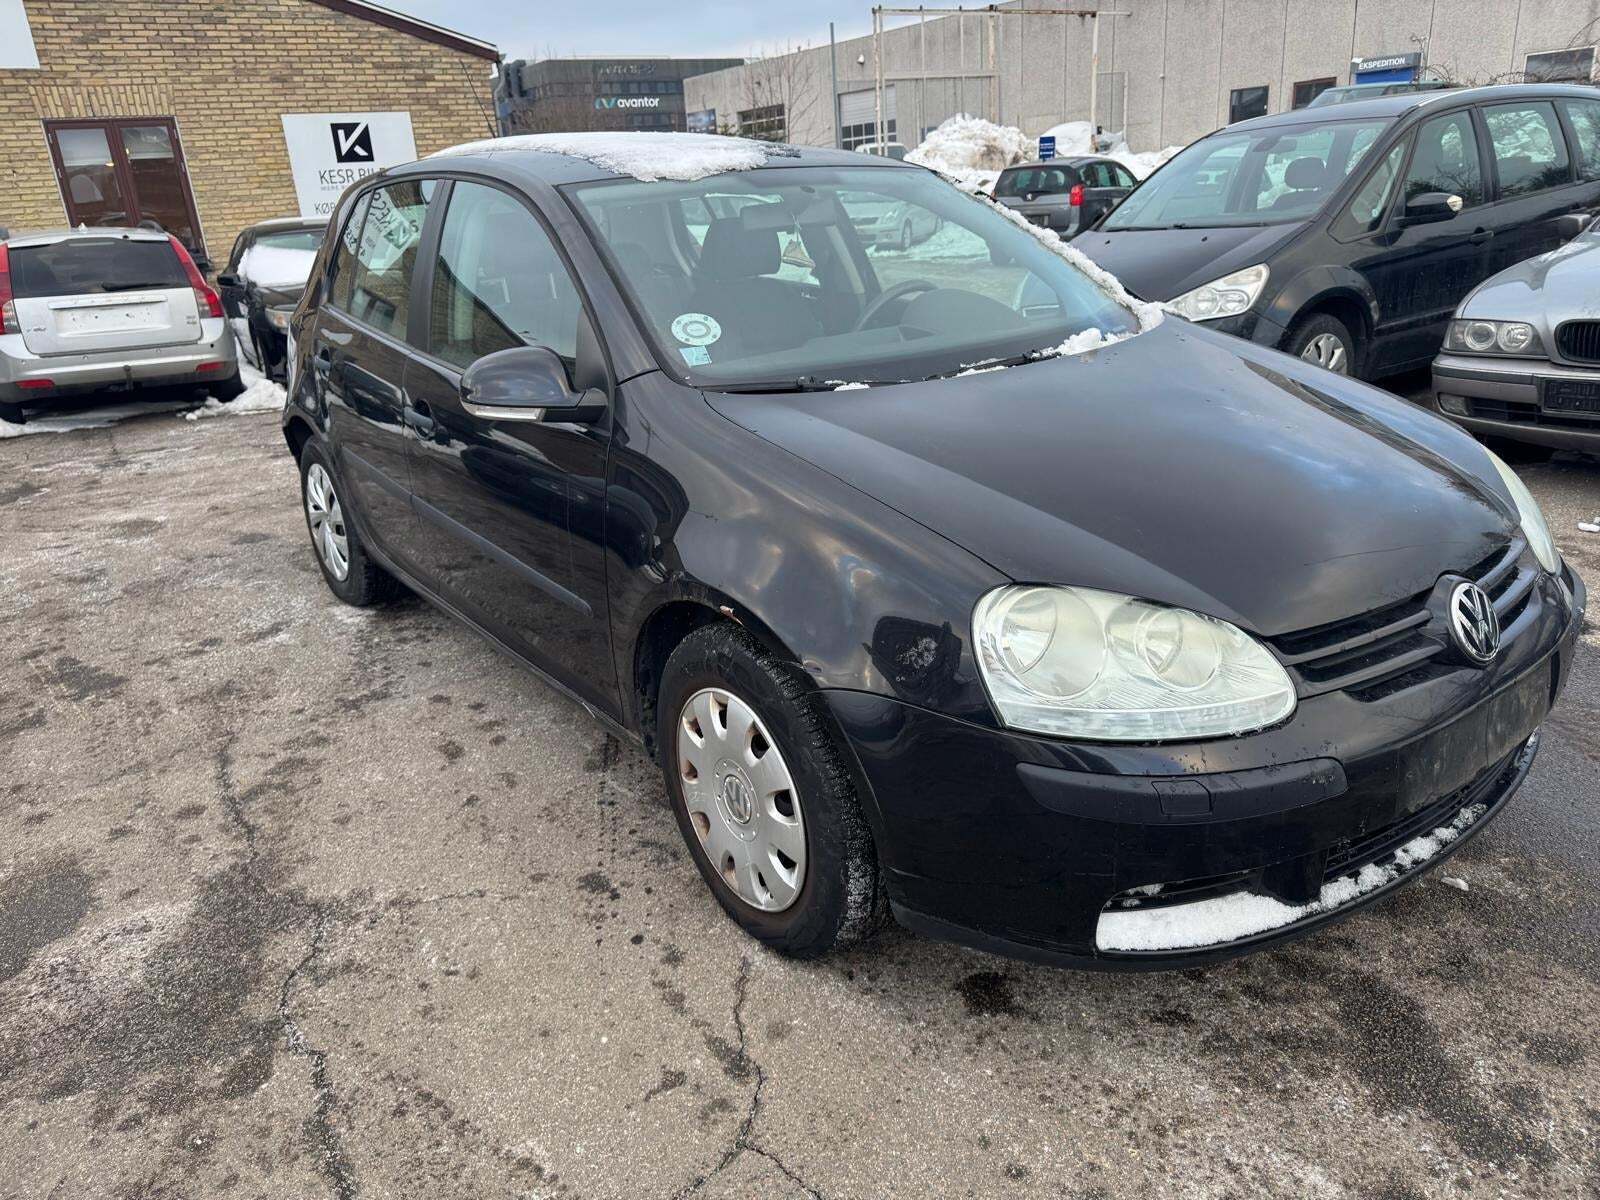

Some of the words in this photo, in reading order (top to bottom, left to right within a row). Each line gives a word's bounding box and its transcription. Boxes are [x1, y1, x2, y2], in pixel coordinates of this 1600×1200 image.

[1359, 57, 1406, 69] EKSPEDITION
[617, 97, 660, 108] avantor
[319, 168, 355, 185] KESR
